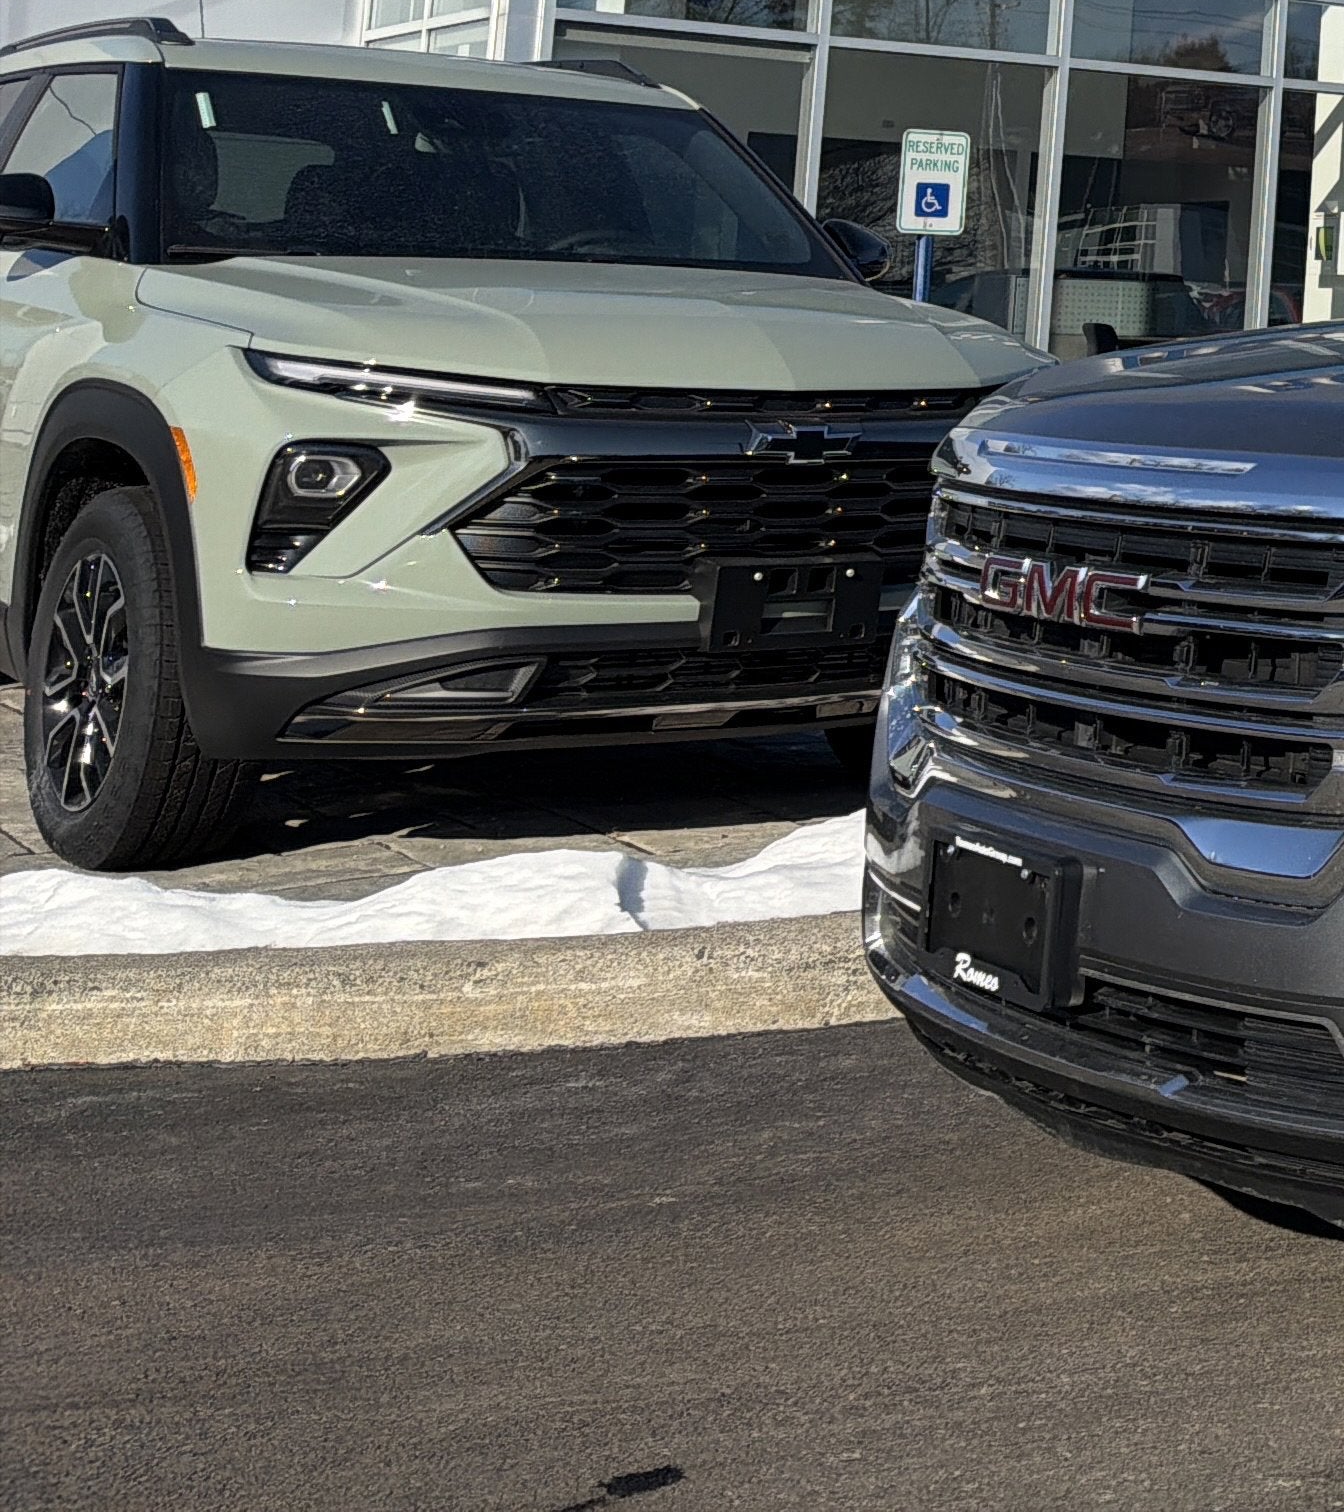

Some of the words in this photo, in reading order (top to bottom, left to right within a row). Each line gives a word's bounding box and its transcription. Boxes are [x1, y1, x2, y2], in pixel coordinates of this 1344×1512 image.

[907, 140, 965, 156] RESERVED
[909, 157, 960, 173] PARKING
[980, 554, 1149, 635] GMC
[953, 952, 1000, 992] Romeo
